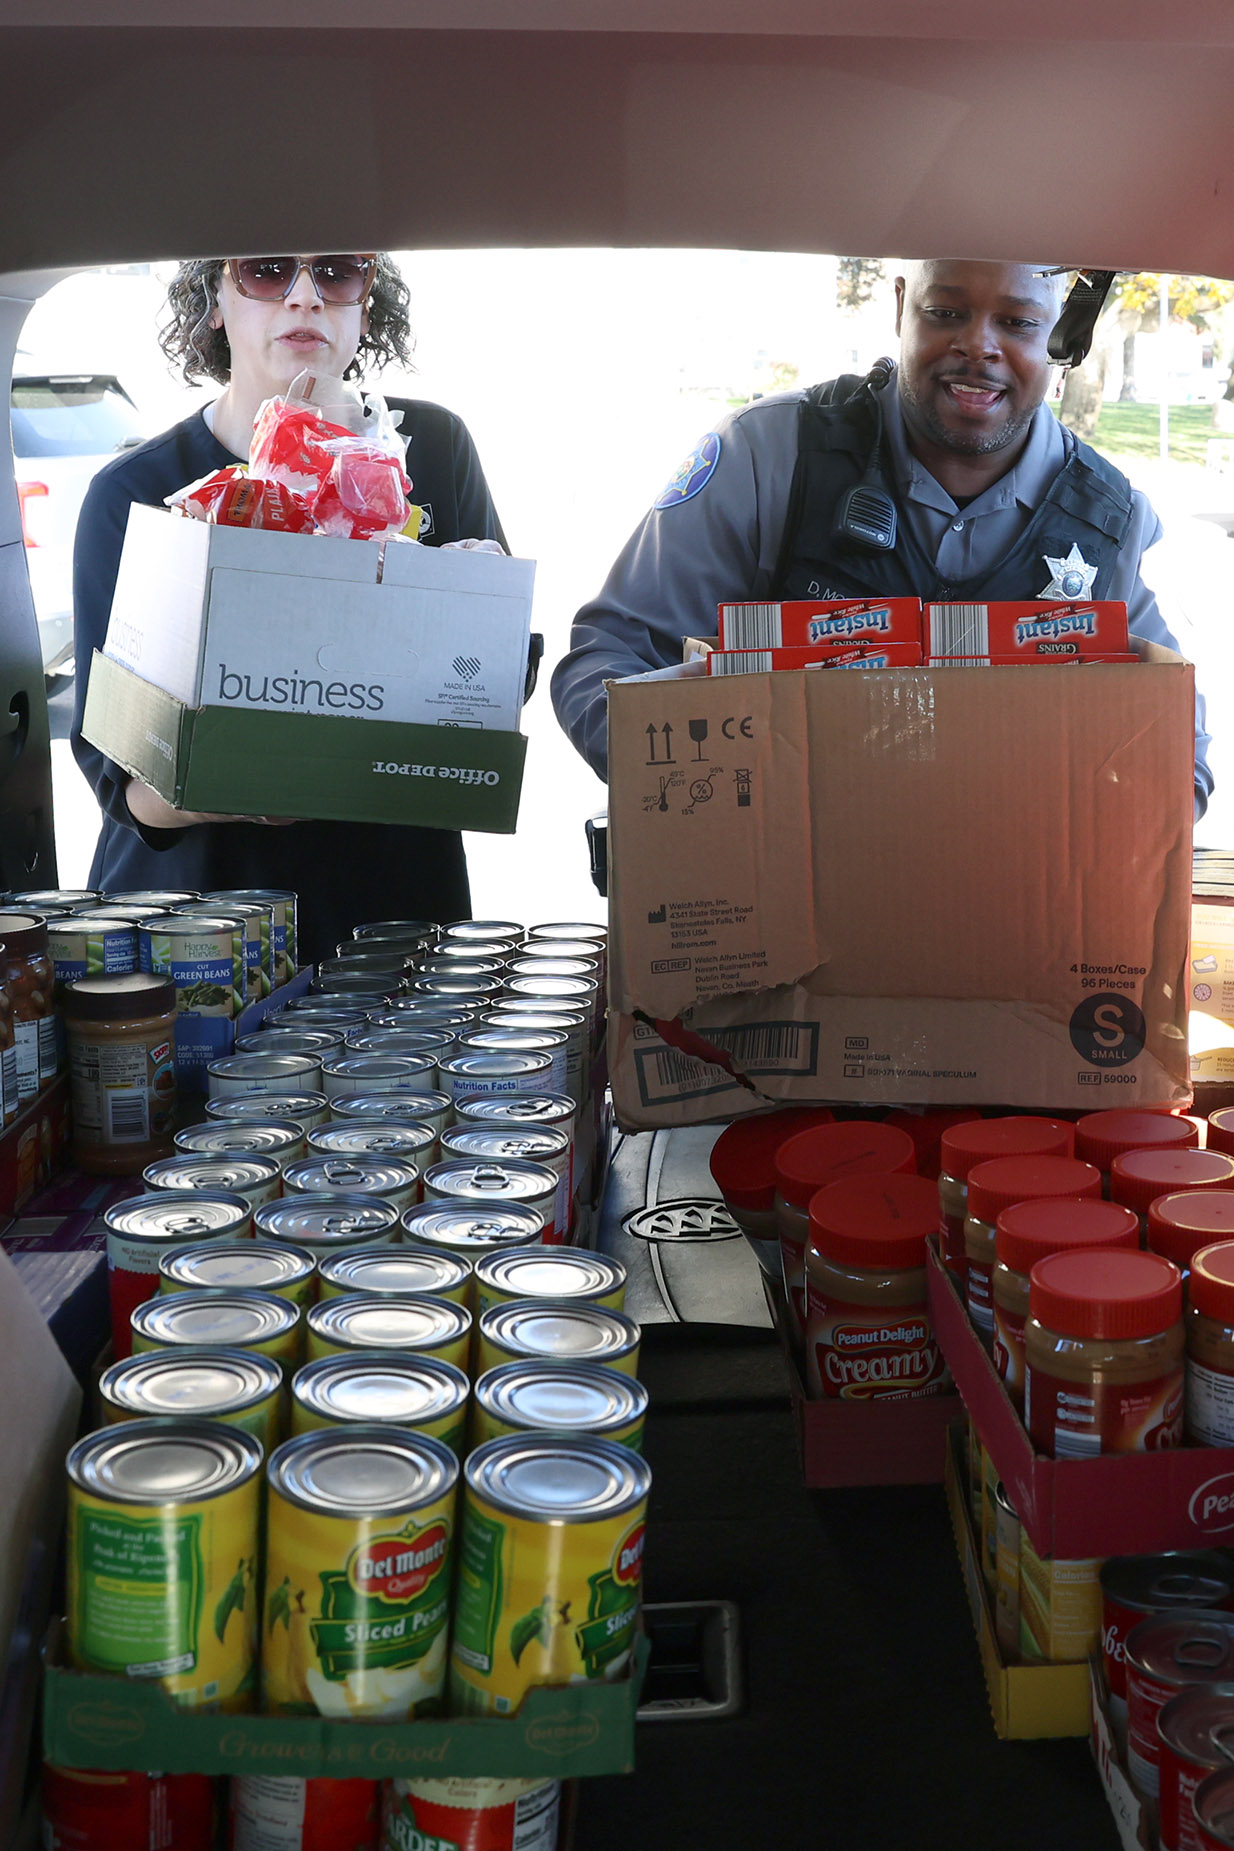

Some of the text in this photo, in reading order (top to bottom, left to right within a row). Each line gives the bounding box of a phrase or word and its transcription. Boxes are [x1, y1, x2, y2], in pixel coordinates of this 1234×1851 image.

[807, 580, 820, 598] D.
[810, 609, 889, 642] Instant
[1016, 613, 1095, 644] Instant
[1038, 643, 1077, 654] GRAINS
[219, 664, 385, 711] business
[444, 682, 463, 690] MADE
[722, 716, 753, 739] CE
[373, 761, 500, 786] Office DEPOT
[669, 902, 693, 911] Welch
[669, 910, 688, 919] 4341
[710, 908, 733, 916] Street
[734, 906, 754, 914] Road
[692, 929, 708, 937] USA
[184, 942, 213, 952] Happy
[671, 940, 717, 949] hillrom.com
[188, 949, 222, 959] Harvest
[694, 956, 718, 964] Welch
[738, 951, 766, 960] Limited
[106, 964, 134, 973] Calories
[654, 960, 688, 972] EC REP
[695, 960, 769, 973] Navan Business Park
[1070, 963, 1147, 975] 4 Boxes/Case
[55, 970, 83, 979] BEANS
[173, 968, 231, 981] GREEN BEANS
[695, 972, 740, 983] Dublin Road
[1081, 978, 1136, 989] 96 Pieces
[1092, 1003, 1125, 1048] S
[1091, 1050, 1128, 1059] SMALL
[932, 1070, 977, 1079] SPECULUM
[1080, 1074, 1137, 1084] REF 59000
[453, 1080, 489, 1091] Nutrition
[491, 1080, 517, 1091] Facts
[837, 1326, 925, 1346] Peanut Delight
[824, 1345, 940, 1384] Creamy
[911, 1384, 938, 1398] BUTTER
[123, 1529, 144, 1542] and
[360, 1537, 446, 1580] Del Monte
[387, 1574, 427, 1593] Quality
[606, 1606, 637, 1636] Slice
[344, 1617, 406, 1643] Sliced
[370, 1737, 456, 1763] Good
